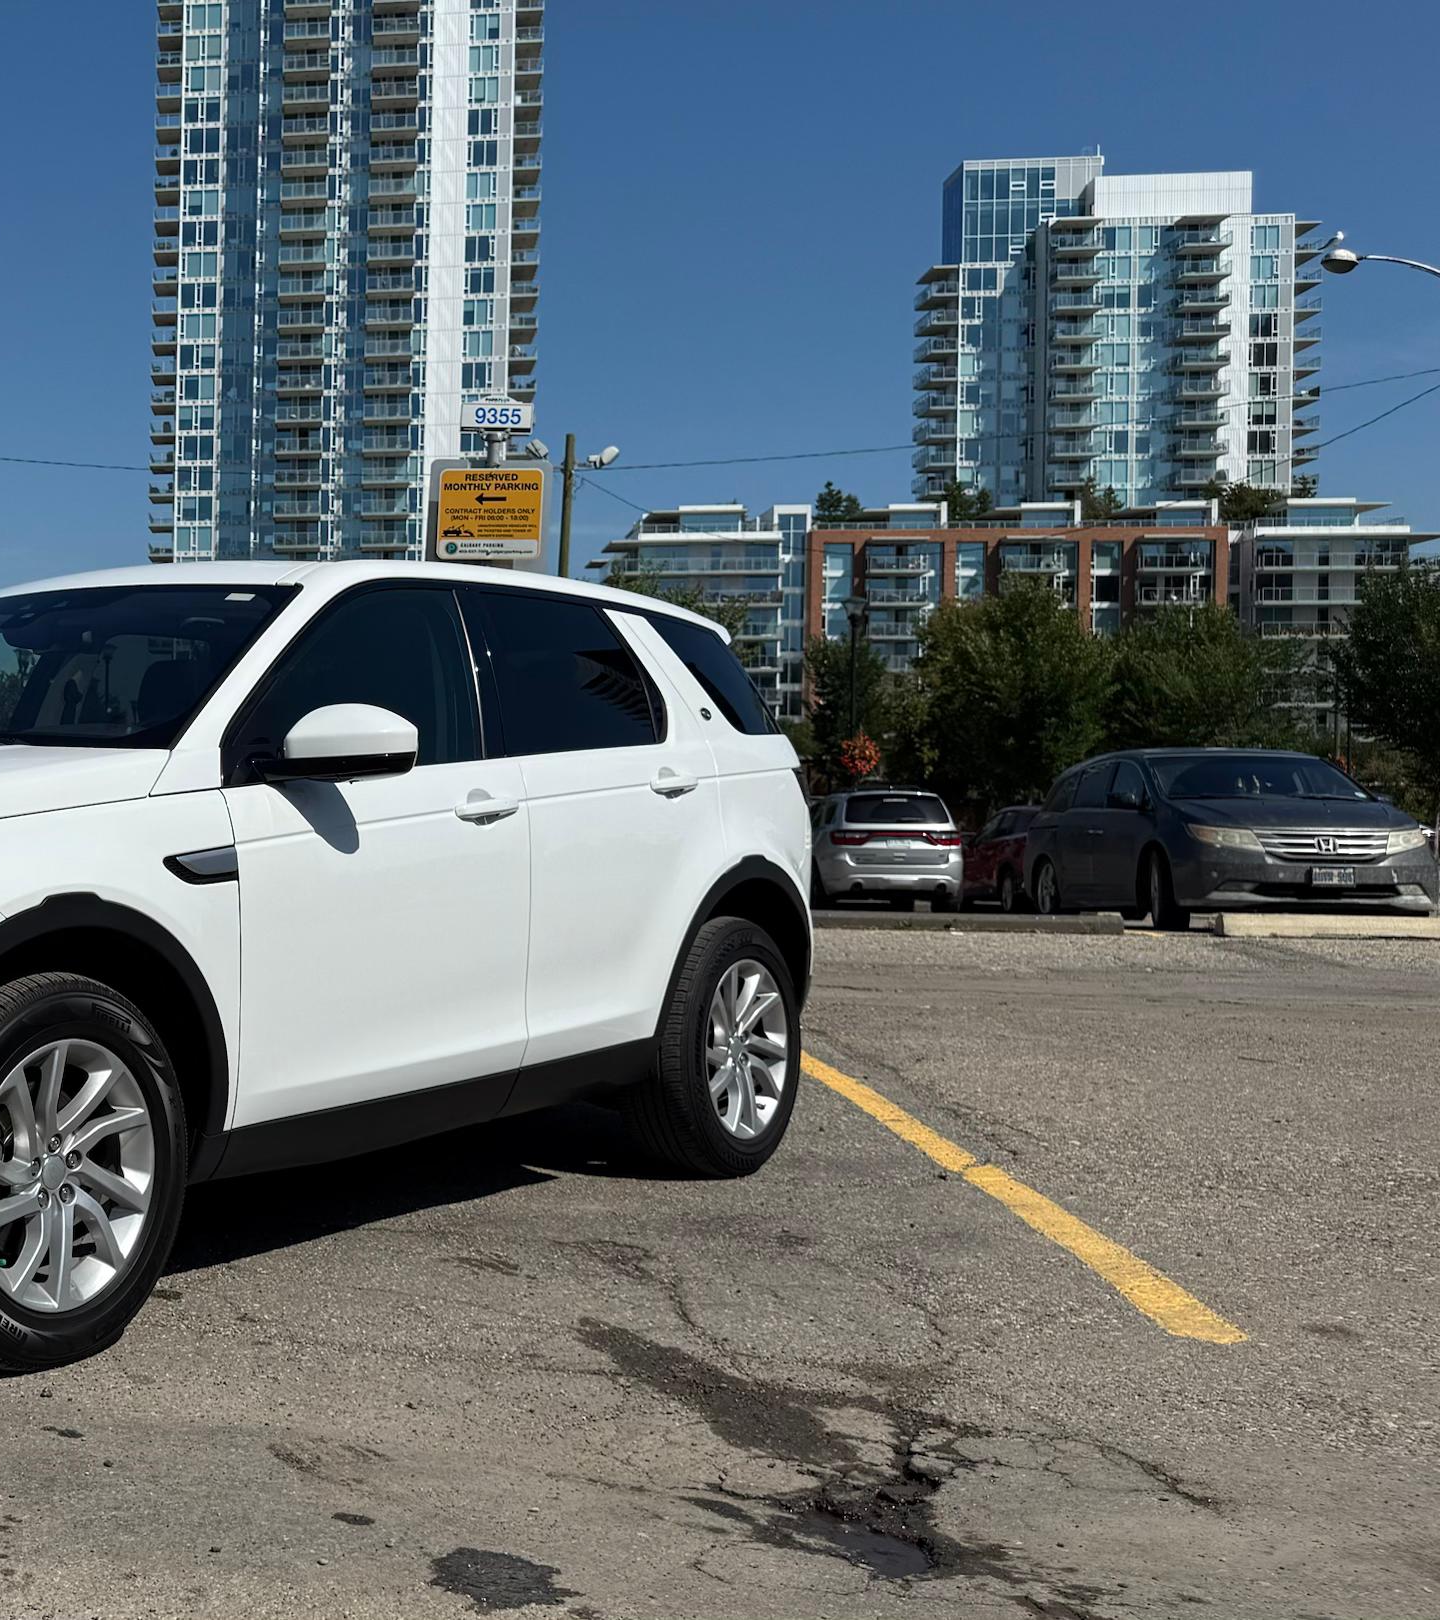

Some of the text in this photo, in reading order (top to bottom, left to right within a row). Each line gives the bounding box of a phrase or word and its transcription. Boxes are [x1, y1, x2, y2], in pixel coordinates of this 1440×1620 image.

[474, 407, 521, 425] 9355
[465, 473, 518, 481] RESERVED
[444, 482, 539, 491] MONTHLY PARKING
[91, 1002, 131, 1034] PIRELLI
